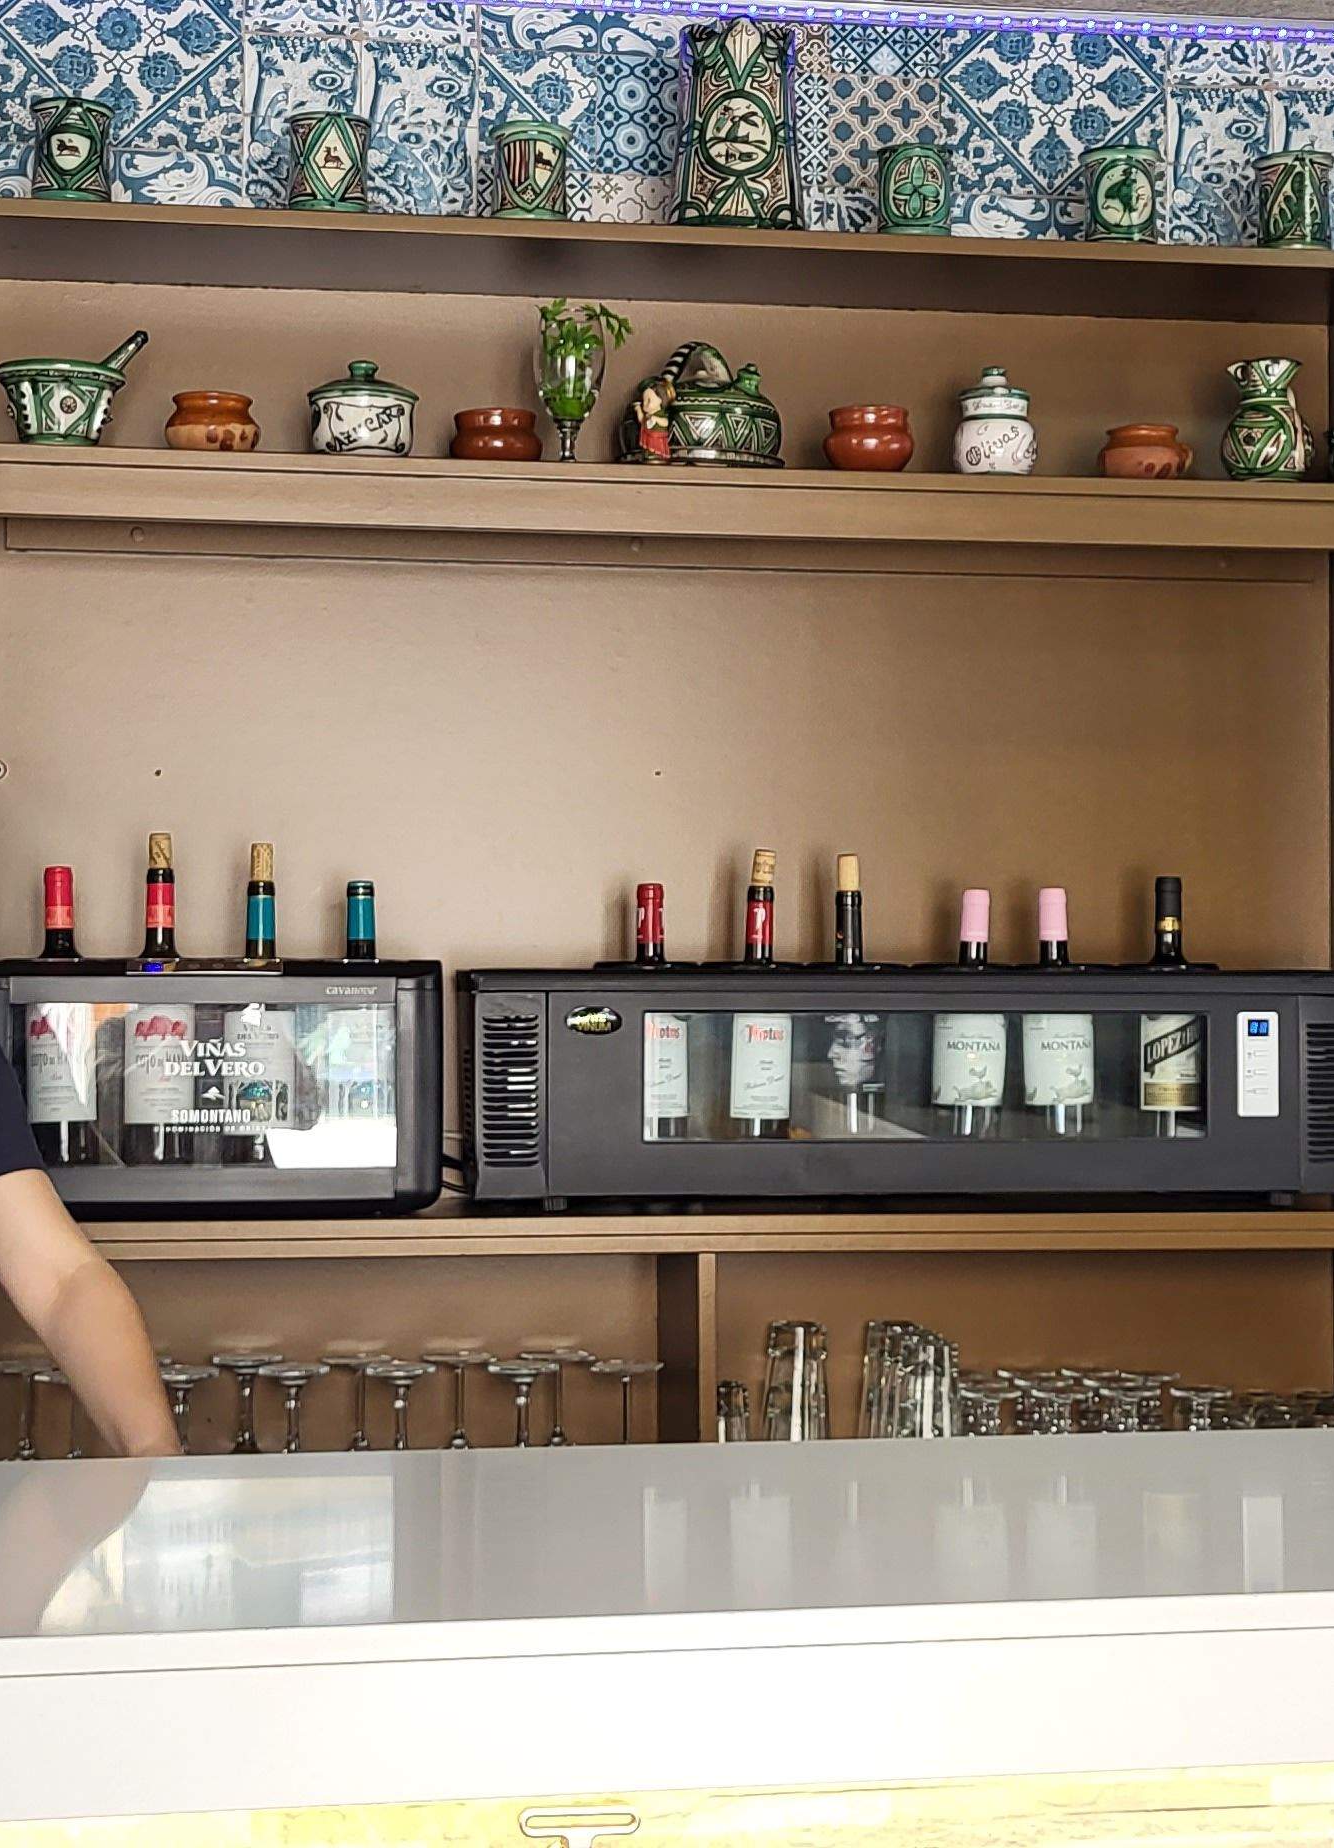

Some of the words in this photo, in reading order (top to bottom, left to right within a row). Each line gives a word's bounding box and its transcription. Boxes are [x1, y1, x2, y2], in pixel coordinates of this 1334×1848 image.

[180, 1037, 246, 1057] VIÑAS
[164, 1061, 205, 1076] DEL
[205, 1058, 265, 1077] VERO
[171, 1109, 251, 1123] SOMONTANO
